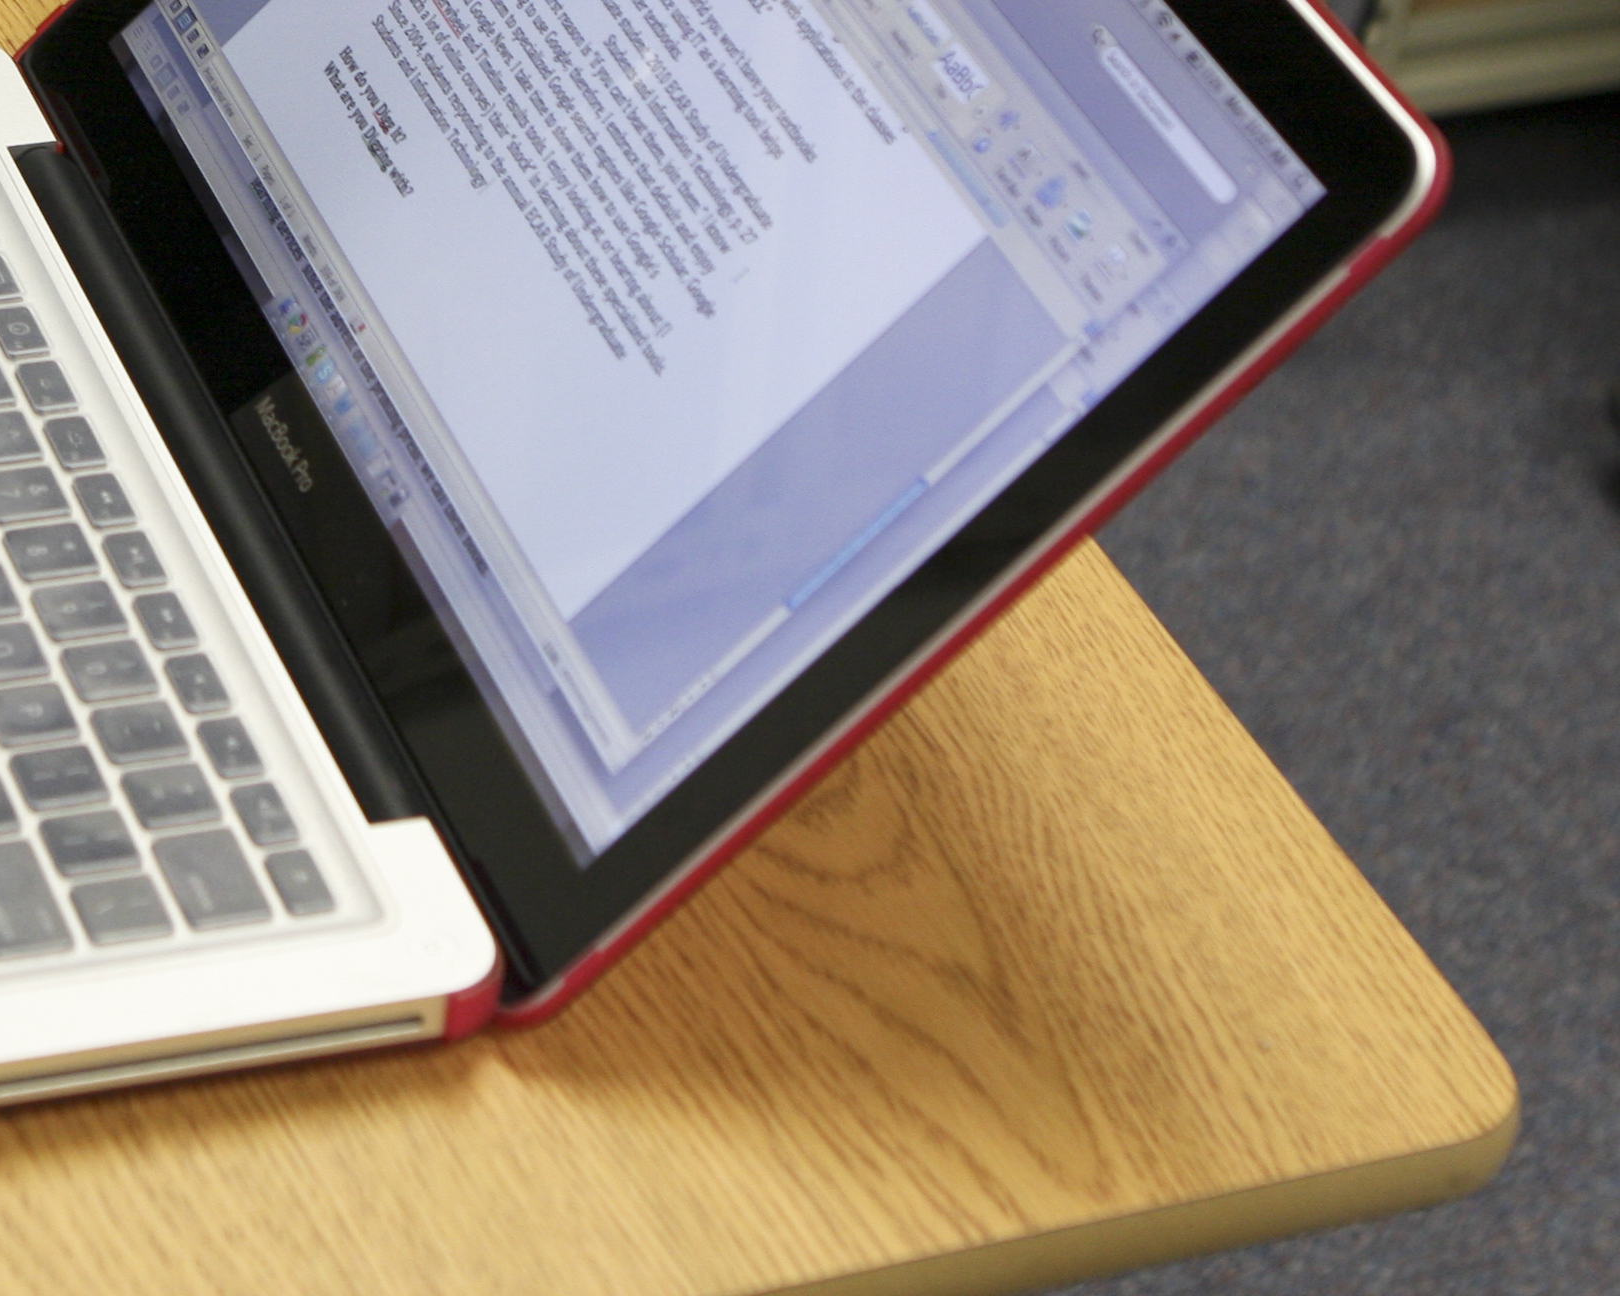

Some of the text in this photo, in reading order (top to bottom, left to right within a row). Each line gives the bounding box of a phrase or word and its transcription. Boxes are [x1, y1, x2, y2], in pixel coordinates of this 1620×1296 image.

[339, 45, 406, 144] How do you Digg It?
[372, 14, 487, 188] Students and Information Technology
[643, 9, 680, 60] textbooks.
[700, 13, 722, 36] you
[739, 59, 762, 88] have
[776, 110, 816, 162] textbooks
[796, 18, 845, 79] applications
[324, 60, 413, 196] What are you Digging with?
[404, 23, 426, 56] 2004,
[421, 52, 452, 94] students
[448, 92, 487, 151] responding
[483, 145, 495, 160] to
[501, 175, 531, 211] annual
[524, 206, 550, 241] ECAR
[543, 236, 567, 270] Study
[562, 268, 580, 282] of
[469, 1, 495, 37] Google
[490, 32, 513, 66] News.
[514, 68, 533, 93] take
[528, 89, 548, 116] time
[544, 112, 556, 127] to
[551, 125, 575, 153] show
[570, 151, 592, 181] them
[588, 176, 609, 202] how
[603, 199, 616, 217] to
[612, 214, 630, 236] use
[603, 34, 636, 80] Students
[633, 79, 654, 100] and
[647, 96, 692, 158] Information
[690, 154, 734, 218] Technology,
[738, 226, 758, 244] 27
[255, 395, 313, 493] MacBook Pro
